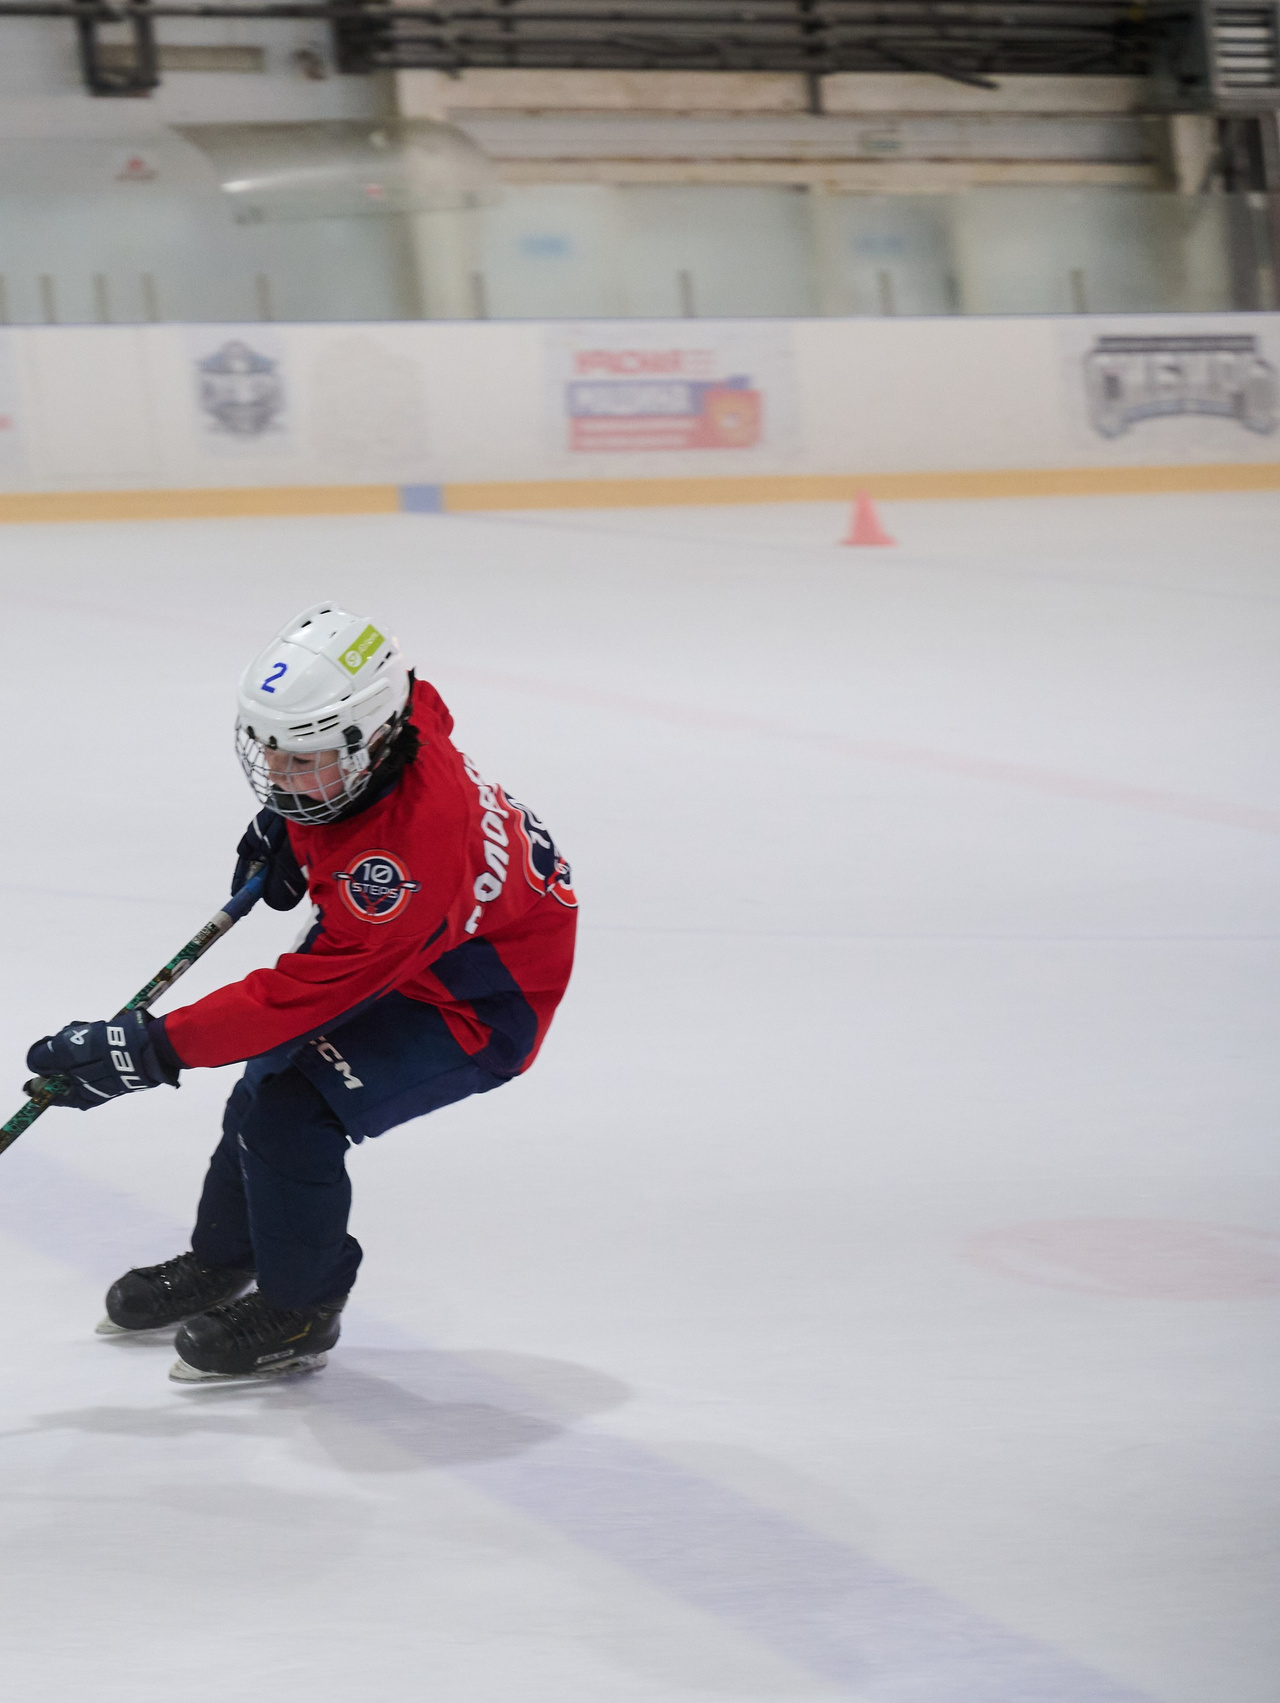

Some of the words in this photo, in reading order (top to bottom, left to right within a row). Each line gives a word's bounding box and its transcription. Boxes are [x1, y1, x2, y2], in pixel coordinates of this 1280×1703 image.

[260, 662, 289, 693] 2
[362, 863, 393, 884] 10
[351, 882, 399, 899] STEPS
